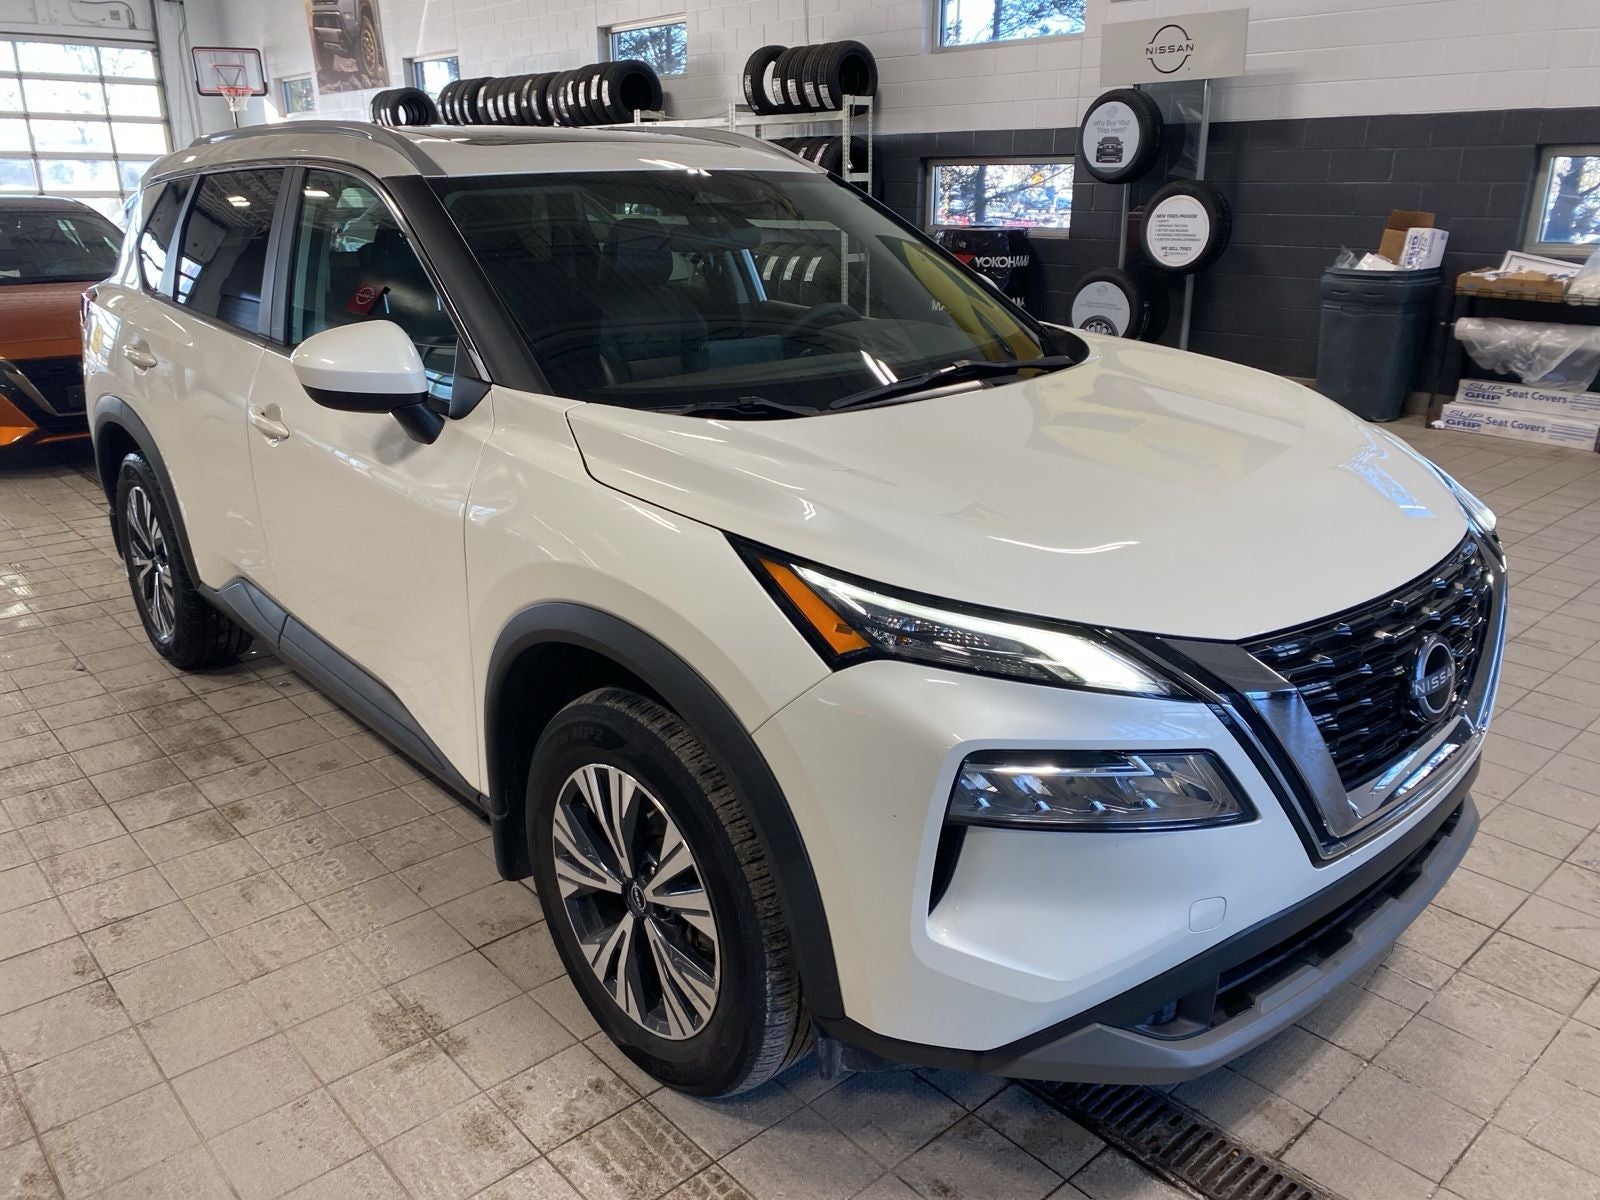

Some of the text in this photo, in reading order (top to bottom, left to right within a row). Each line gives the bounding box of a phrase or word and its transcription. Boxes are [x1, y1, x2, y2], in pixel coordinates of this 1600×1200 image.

[1145, 43, 1194, 55] NISSAN
[1467, 382, 1504, 392] SLIP
[1464, 391, 1502, 400] GRIP
[1505, 388, 1530, 399] Seat
[1532, 391, 1568, 404] Covers
[1449, 409, 1484, 419] SLIP
[1445, 418, 1482, 429] GRIP
[1485, 416, 1508, 428] Seat
[1510, 420, 1547, 433] Covers
[1414, 667, 1453, 696] NISSA
